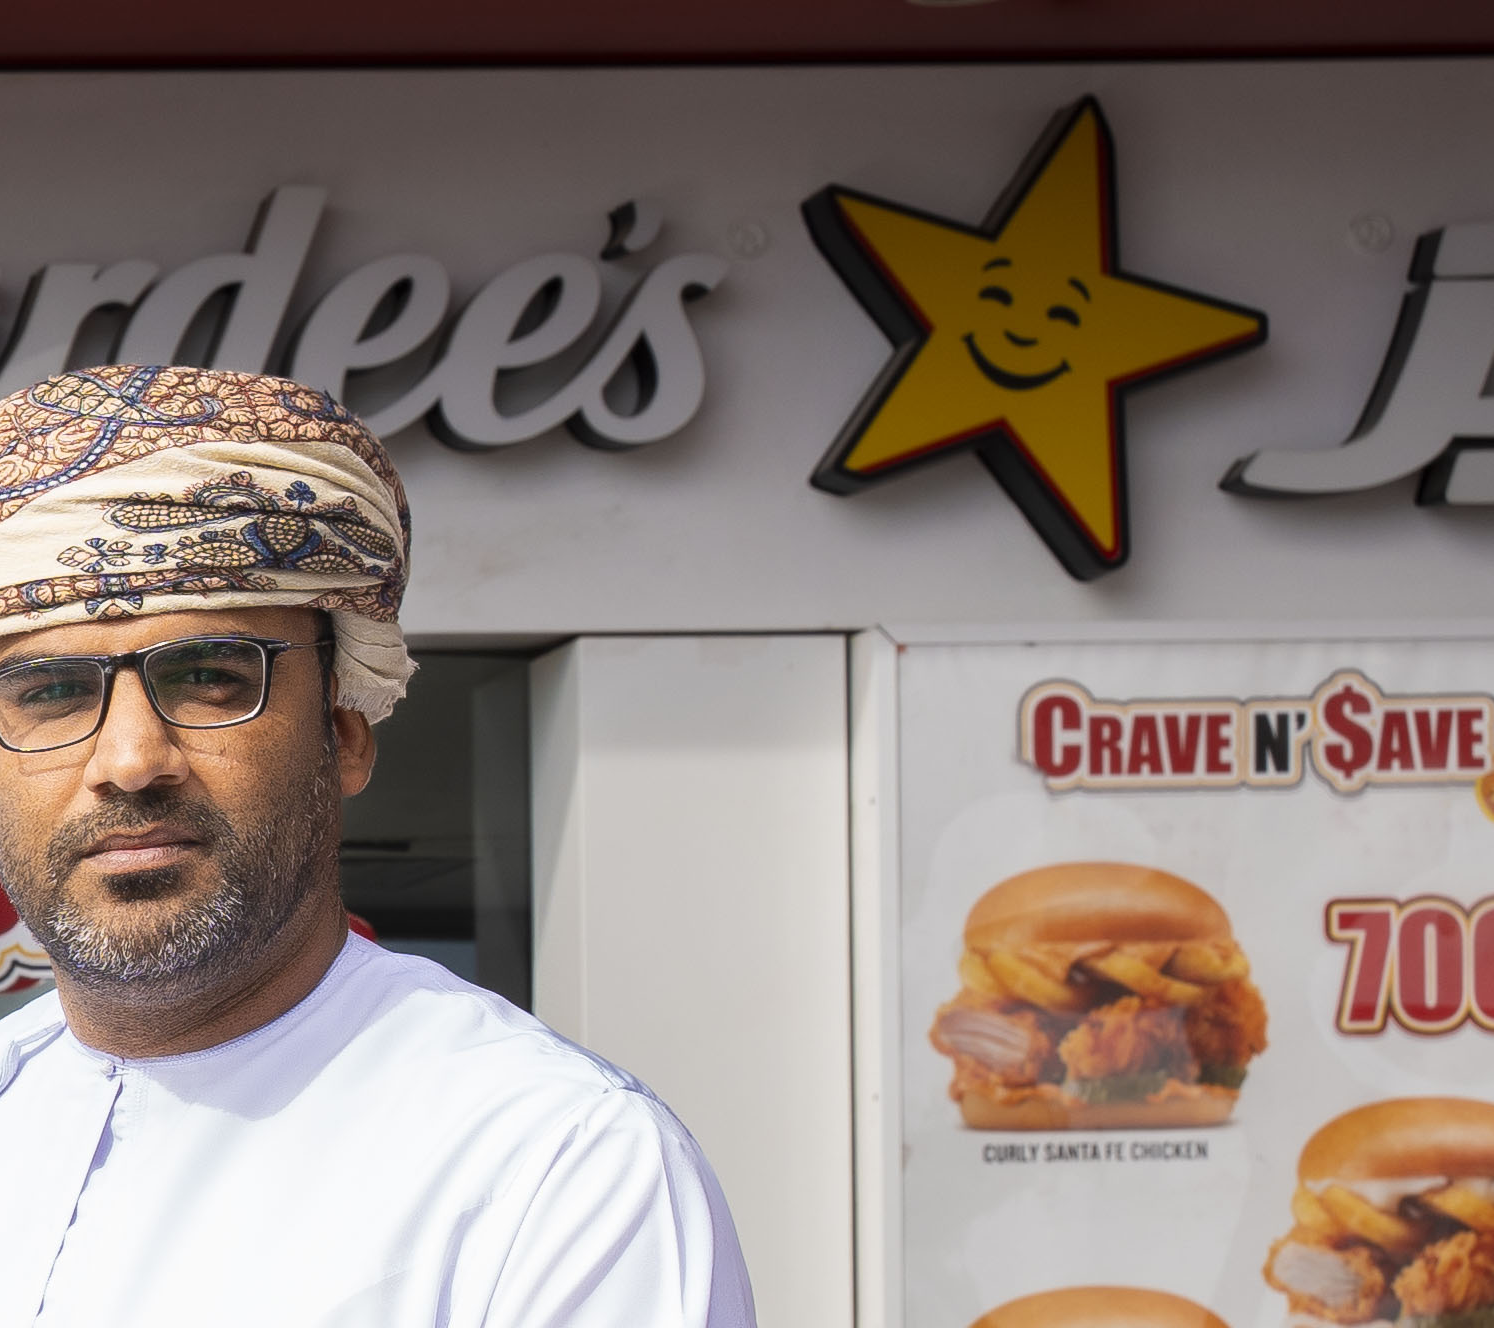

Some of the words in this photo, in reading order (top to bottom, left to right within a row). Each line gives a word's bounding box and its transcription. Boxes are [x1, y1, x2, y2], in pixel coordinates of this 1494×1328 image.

[1033, 693, 1232, 779] CRAVE
[1254, 711, 1308, 774] N'
[982, 1142, 1039, 1163] CURLY
[1045, 1141, 1100, 1162] SANTA
[1105, 1141, 1124, 1161] FE
[1130, 1140, 1209, 1161] CHICKEN
